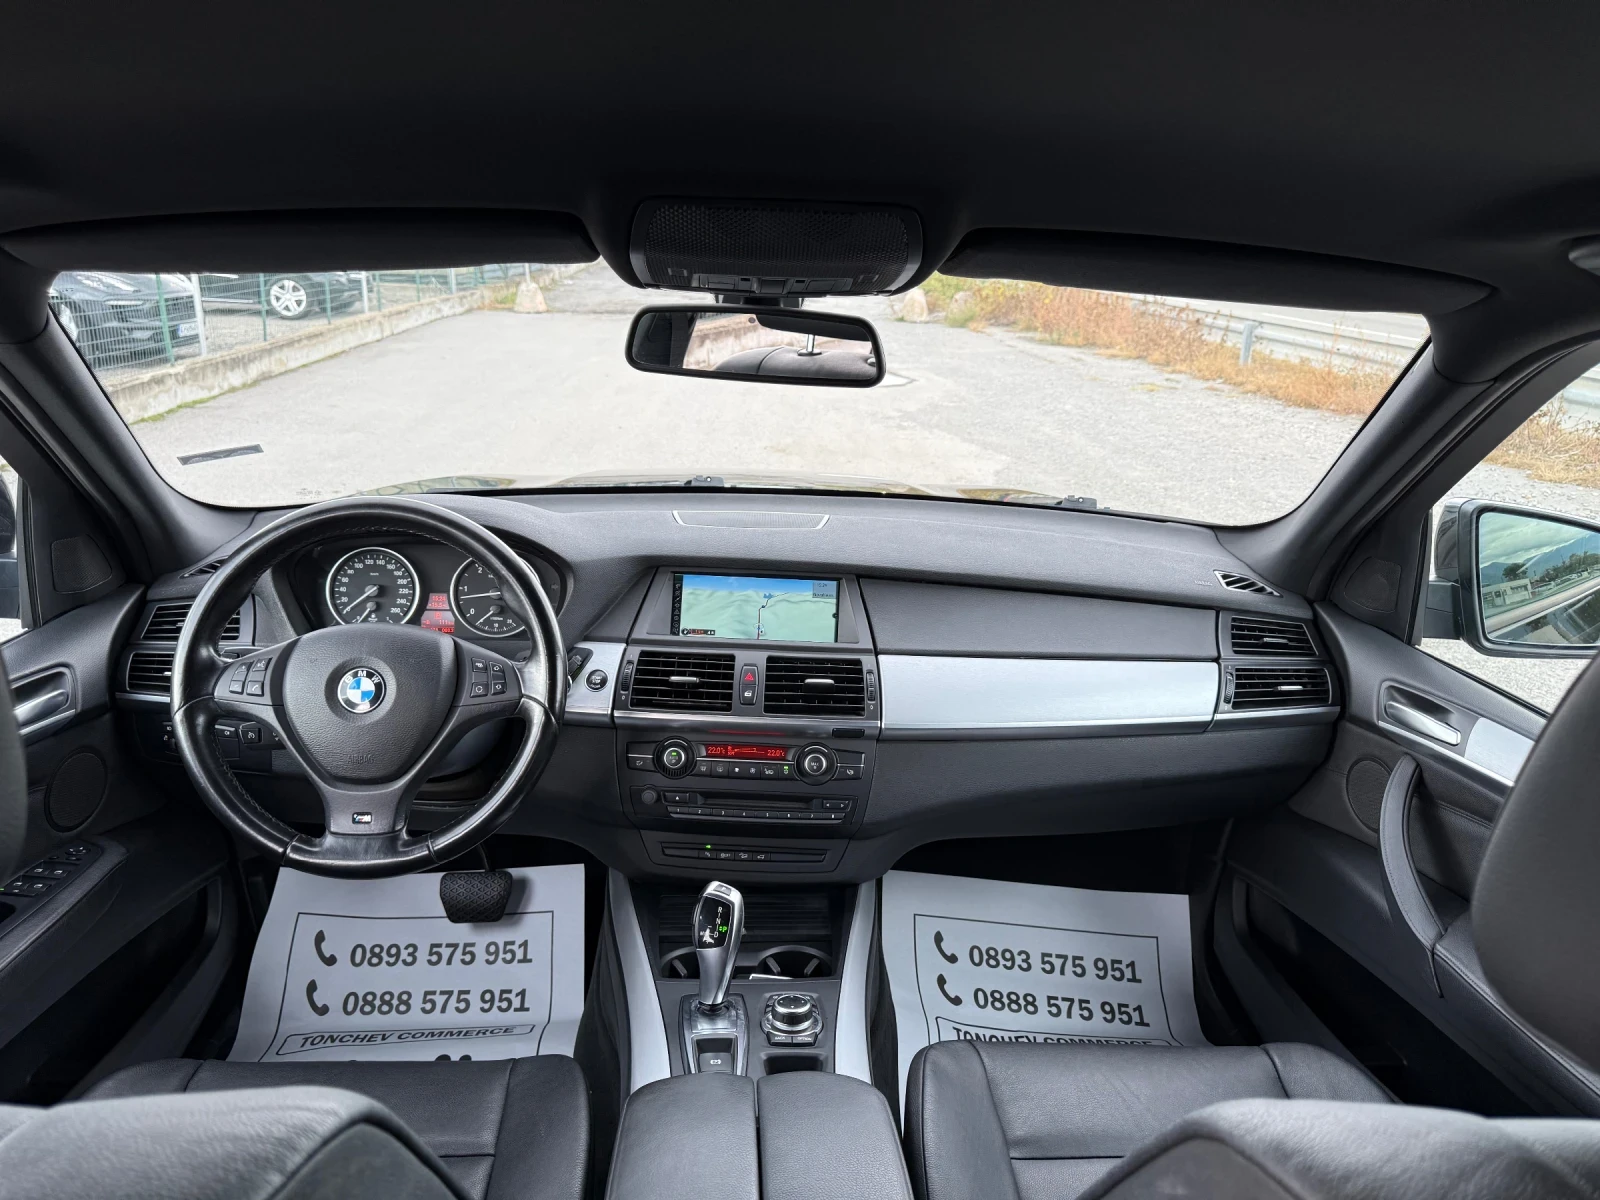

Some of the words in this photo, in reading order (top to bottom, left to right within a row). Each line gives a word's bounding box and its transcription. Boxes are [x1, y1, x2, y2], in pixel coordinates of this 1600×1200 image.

[345, 671, 380, 683] BMW
[350, 943, 418, 968] 0893
[426, 942, 476, 967] 575
[484, 939, 533, 966] 951
[968, 945, 1032, 973] 0893
[1040, 952, 1087, 978] 575
[1093, 957, 1143, 984] 951
[342, 991, 413, 1016] 0888
[420, 990, 471, 1015] 575
[479, 988, 530, 1014] 951
[973, 987, 1039, 1015] 0888
[1046, 995, 1094, 1022] 575
[1099, 1000, 1151, 1028] 951
[300, 1033, 394, 1048] TONCHEV
[397, 1027, 516, 1040] COMMERCE
